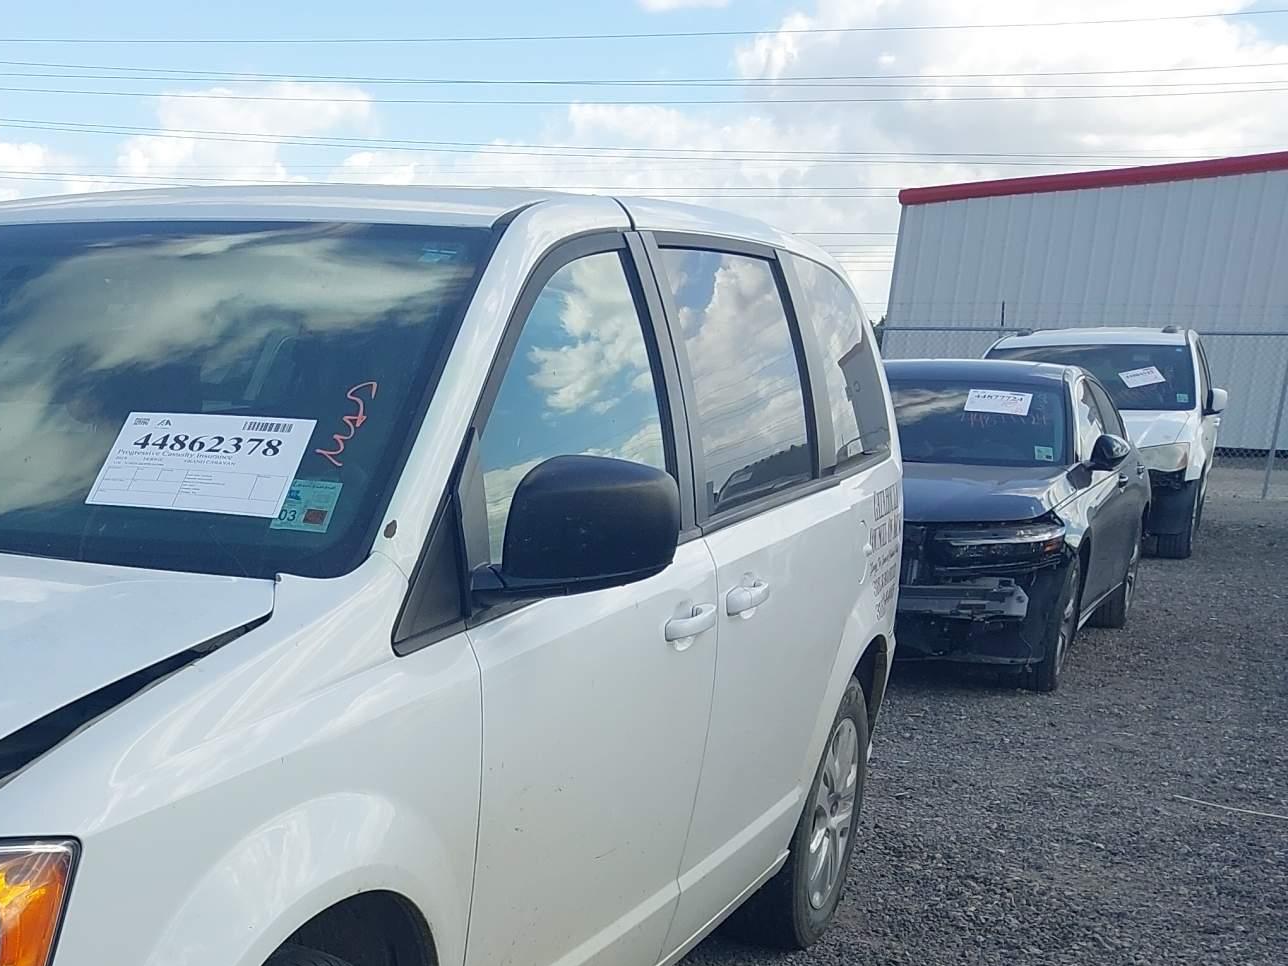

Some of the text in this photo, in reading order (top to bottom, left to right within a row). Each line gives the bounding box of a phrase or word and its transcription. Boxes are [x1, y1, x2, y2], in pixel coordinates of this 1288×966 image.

[133, 431, 283, 457] 44862378
[116, 448, 234, 461] Progressive Casualty Insurance
